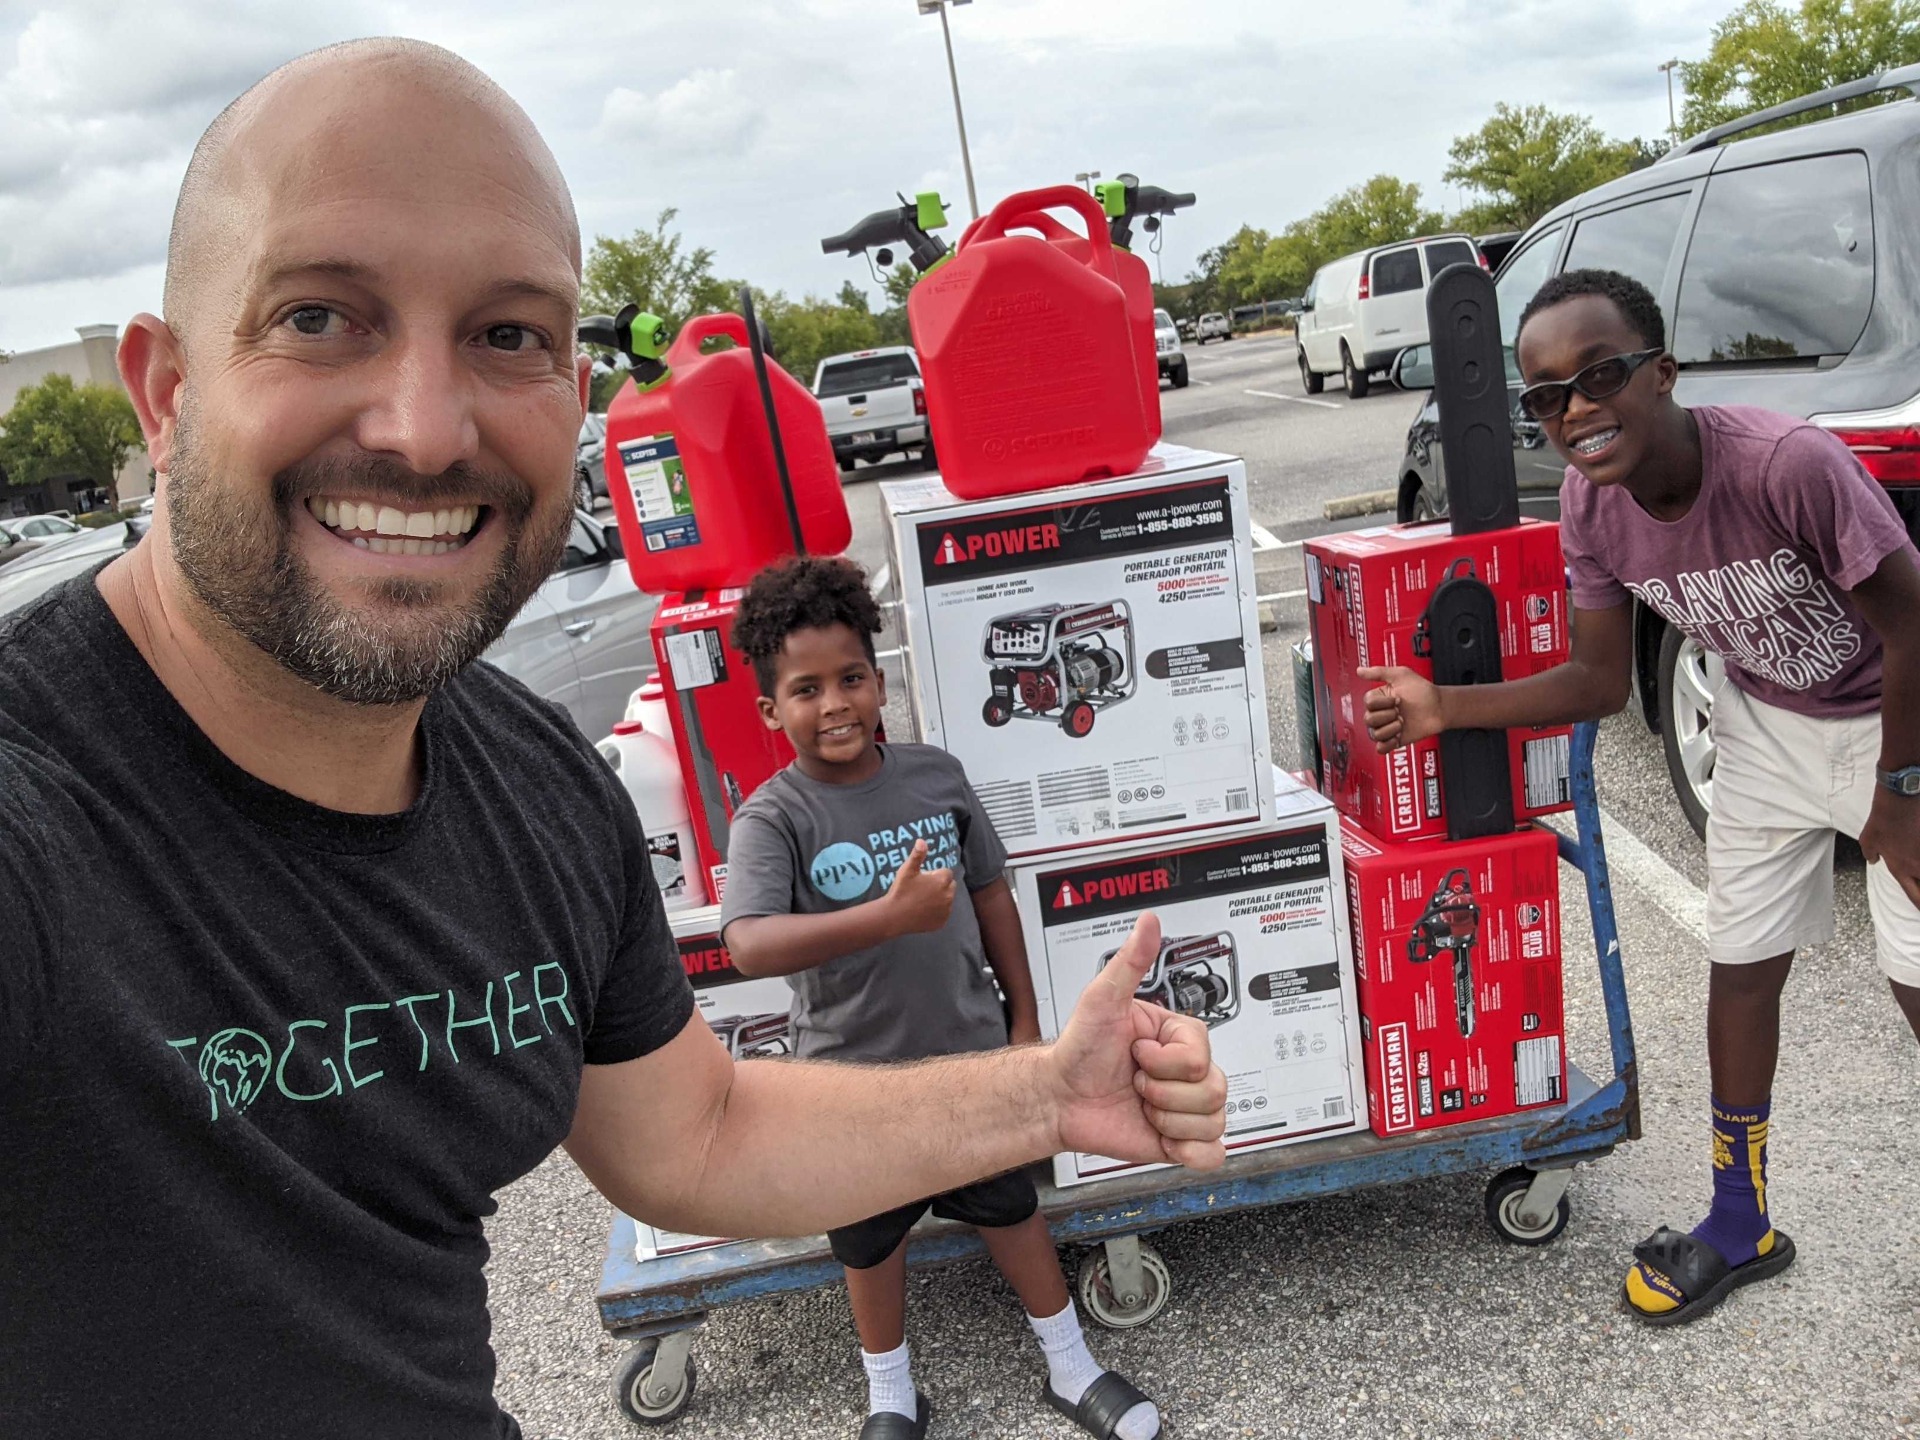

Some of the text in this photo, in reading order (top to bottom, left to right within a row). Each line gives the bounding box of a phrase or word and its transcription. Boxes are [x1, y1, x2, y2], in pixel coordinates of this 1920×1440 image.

[1136, 499, 1222, 521] www.a-ipower.com
[1137, 511, 1223, 535] 1-855-888-3598
[1124, 548, 1227, 573] PORTABLE GENERATOR
[1125, 559, 1226, 583] GENERADOR PORTÁTIL
[976, 592, 997, 601] HOGAR
[1017, 586, 1034, 595] RUDO
[996, 582, 1008, 590] AND
[1009, 579, 1027, 588] WORK
[1157, 578, 1185, 592] 5000
[1159, 591, 1187, 603] 4250
[1538, 623, 1552, 653] CLUB
[1393, 746, 1413, 825] CRAFTSM
[1428, 778, 1440, 818] 2-CYCLE
[868, 812, 955, 850] PRAYING
[874, 831, 959, 870] PELCAN
[1241, 843, 1319, 863] www.a-ipower.com
[814, 857, 871, 887] PPM
[1241, 853, 1320, 875] 1-855-888-3598
[1229, 885, 1324, 908] PORTABLE GENERATOR
[1230, 895, 1323, 918] GENERADOR PORTÁTIL
[1260, 912, 1285, 924] 5000
[1260, 922, 1286, 934] 4250
[1349, 877, 1365, 978] CRAFTSMAN
[1529, 930, 1542, 958] CLUB
[681, 946, 734, 975] WER
[1386, 1030, 1407, 1124] CRAFTSMAN
[1420, 1077, 1433, 1116] 2-CYCLE
[1711, 1106, 1759, 1123] ROJANS
